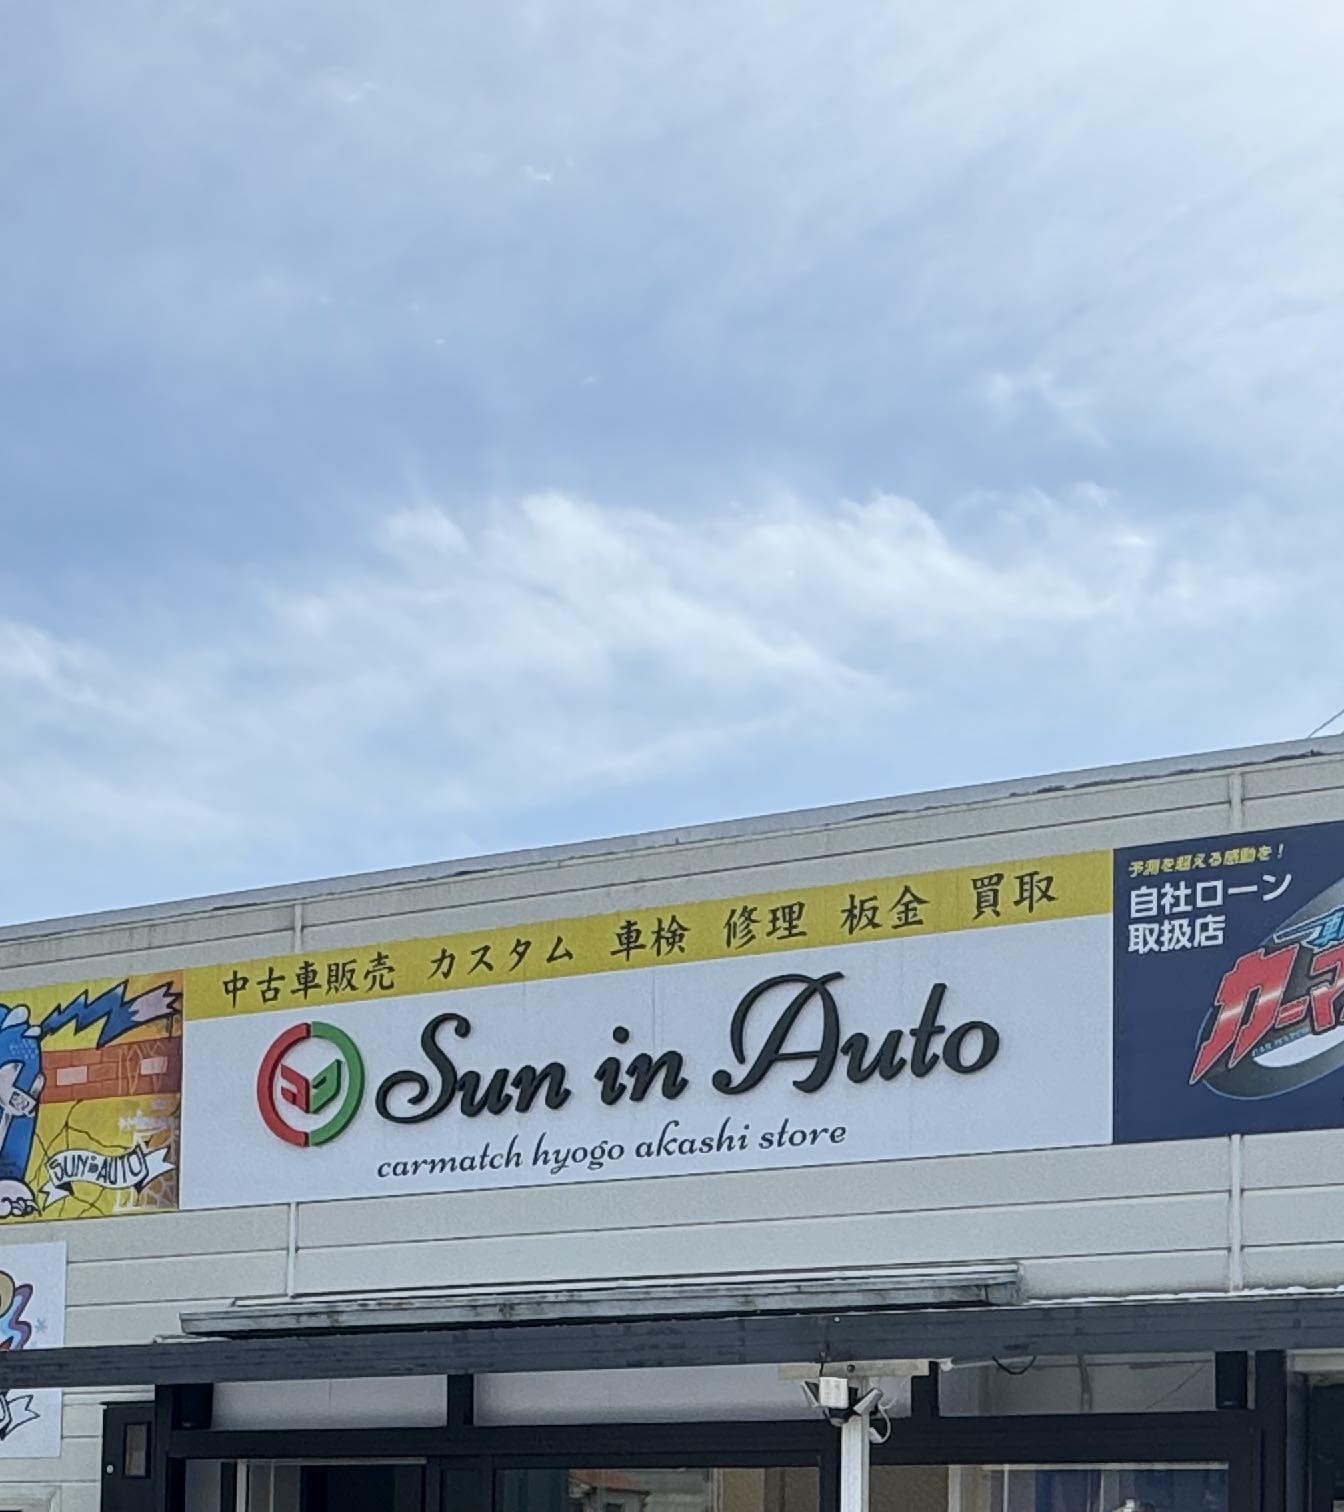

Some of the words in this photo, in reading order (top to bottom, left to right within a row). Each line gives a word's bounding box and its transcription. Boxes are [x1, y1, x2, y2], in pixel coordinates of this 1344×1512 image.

[1128, 843, 1285, 878] 予測を超える感動を！
[1130, 873, 1293, 919] 自社ローン
[222, 951, 396, 1008] 中古車販売
[427, 936, 574, 980] カスタム
[610, 914, 691, 962] 車検
[723, 901, 809, 950] 修理
[840, 885, 931, 935] 板金
[970, 870, 1057, 920] 買取
[1127, 914, 1227, 955] 取扱店
[375, 1012, 571, 1124] Sun
[594, 1025, 689, 1106] in
[711, 971, 1001, 1096] Auto
[376, 1134, 522, 1179] carmatch
[531, 1132, 625, 1175] hyogo
[634, 1116, 750, 1159] akashi
[758, 1118, 847, 1151] store
